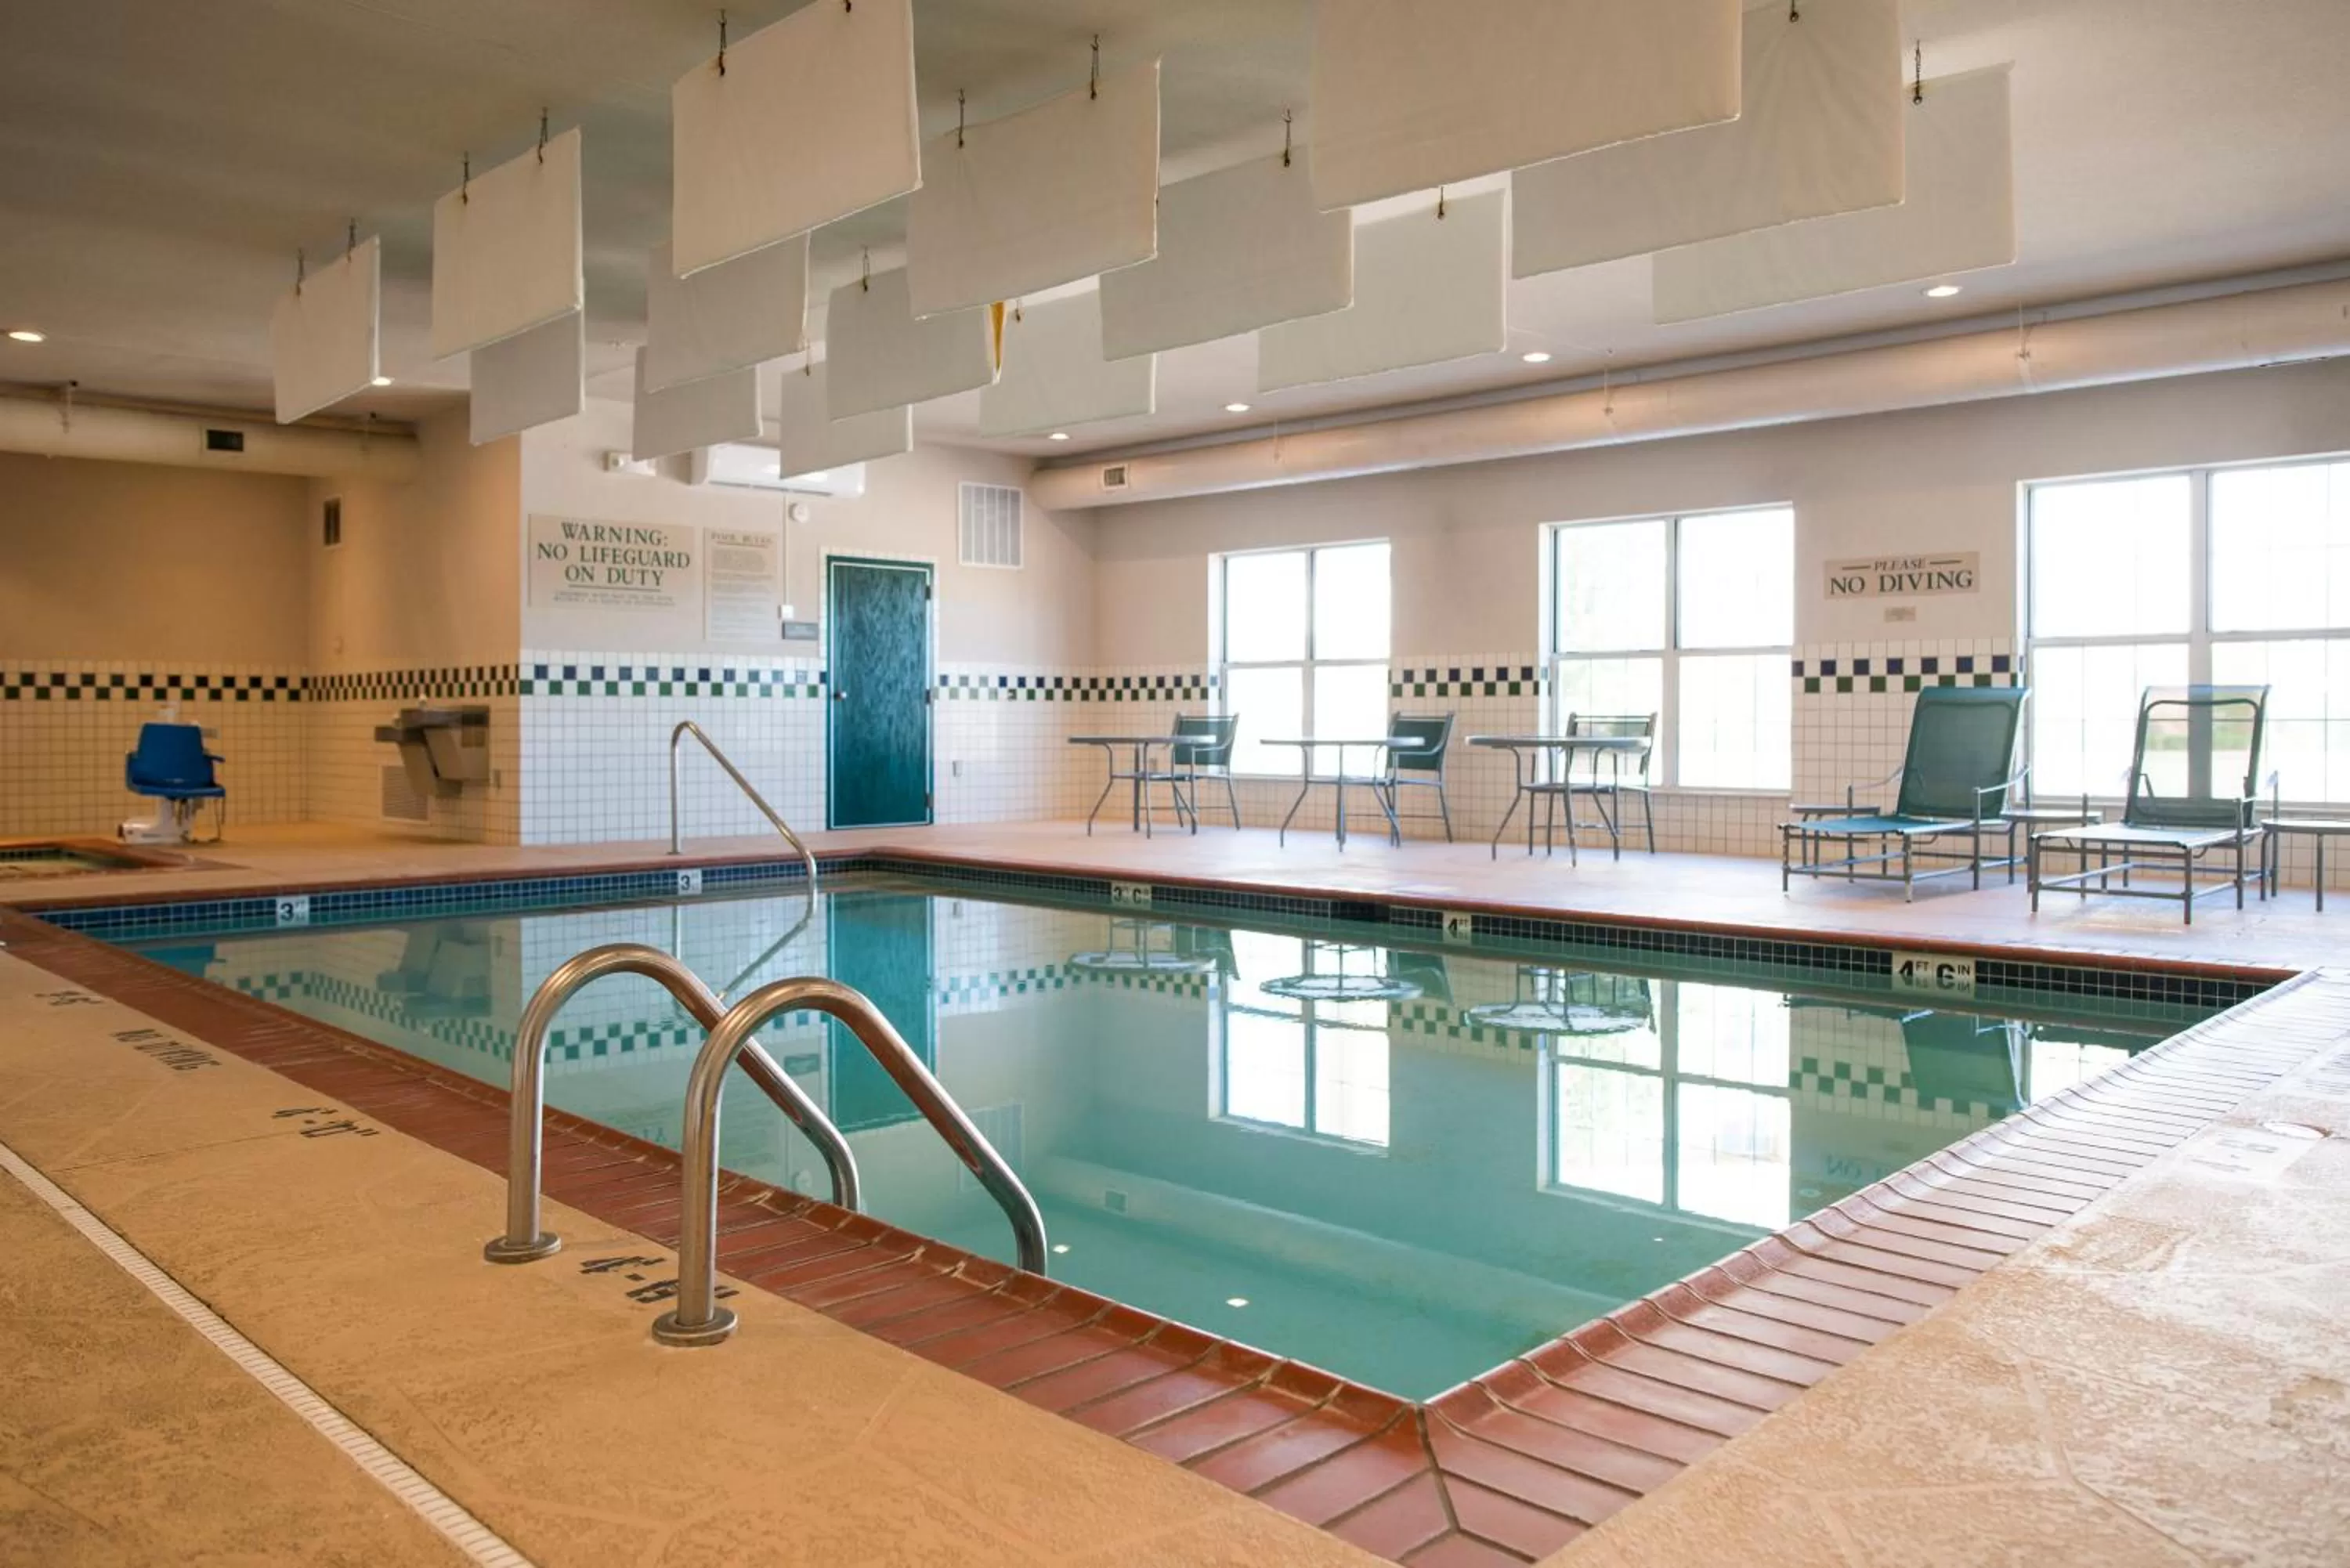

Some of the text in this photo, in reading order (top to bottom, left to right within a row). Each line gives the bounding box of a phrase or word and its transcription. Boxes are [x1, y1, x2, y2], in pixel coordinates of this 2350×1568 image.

[561, 521, 668, 547] WARNING:
[537, 542, 568, 561] NO
[580, 545, 690, 569] LIFEGUARD
[1875, 558, 1925, 571] PLEASE
[564, 564, 663, 587] ON DUTY
[1830, 569, 1972, 595] NO DIVING
[680, 875, 690, 891] 3
[280, 902, 294, 921] 3
[1915, 961, 1929, 972] FT
[1958, 964, 1970, 975] IN
